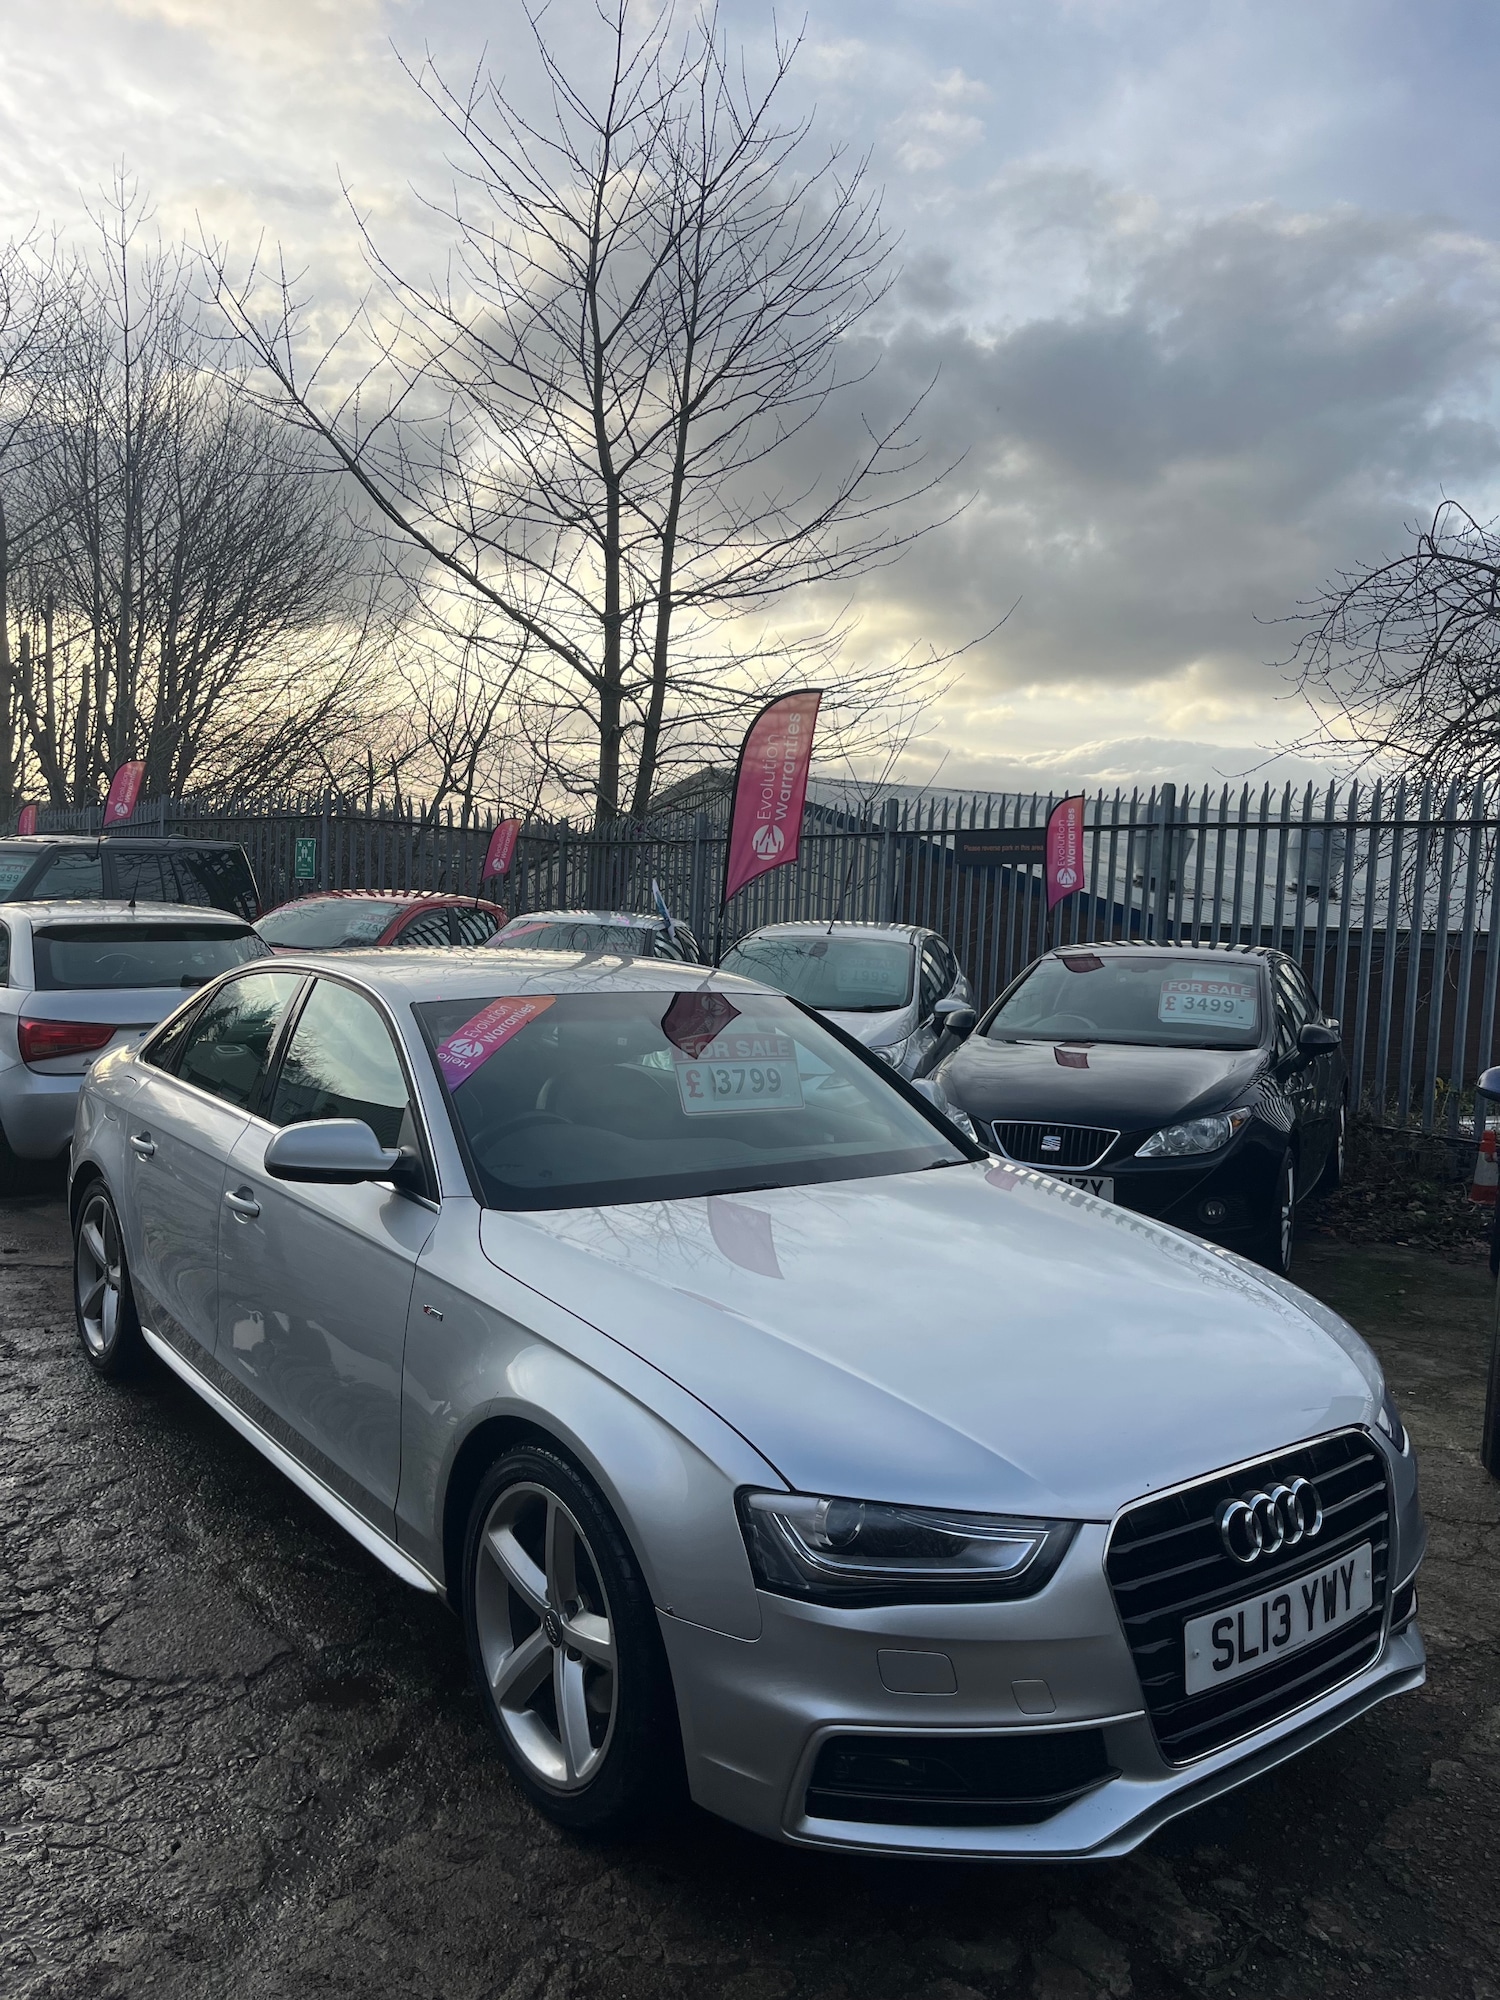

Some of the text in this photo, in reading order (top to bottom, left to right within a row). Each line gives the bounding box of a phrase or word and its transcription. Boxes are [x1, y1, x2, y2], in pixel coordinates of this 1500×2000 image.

[757, 734, 780, 820] Evolution
[1002, 844, 1013, 852] park
[1058, 819, 1066, 866] Evolution
[1066, 808, 1076, 866] Warranties
[1168, 982, 1252, 997] FOR SALE
[1183, 996, 1234, 1013] 3499
[464, 1005, 512, 1038] Evolution
[480, 1003, 536, 1043] Warranties
[437, 1052, 471, 1069] Hello
[680, 1040, 790, 1060] FOR SALE
[1211, 1559, 1355, 1672] SL13 YWY
